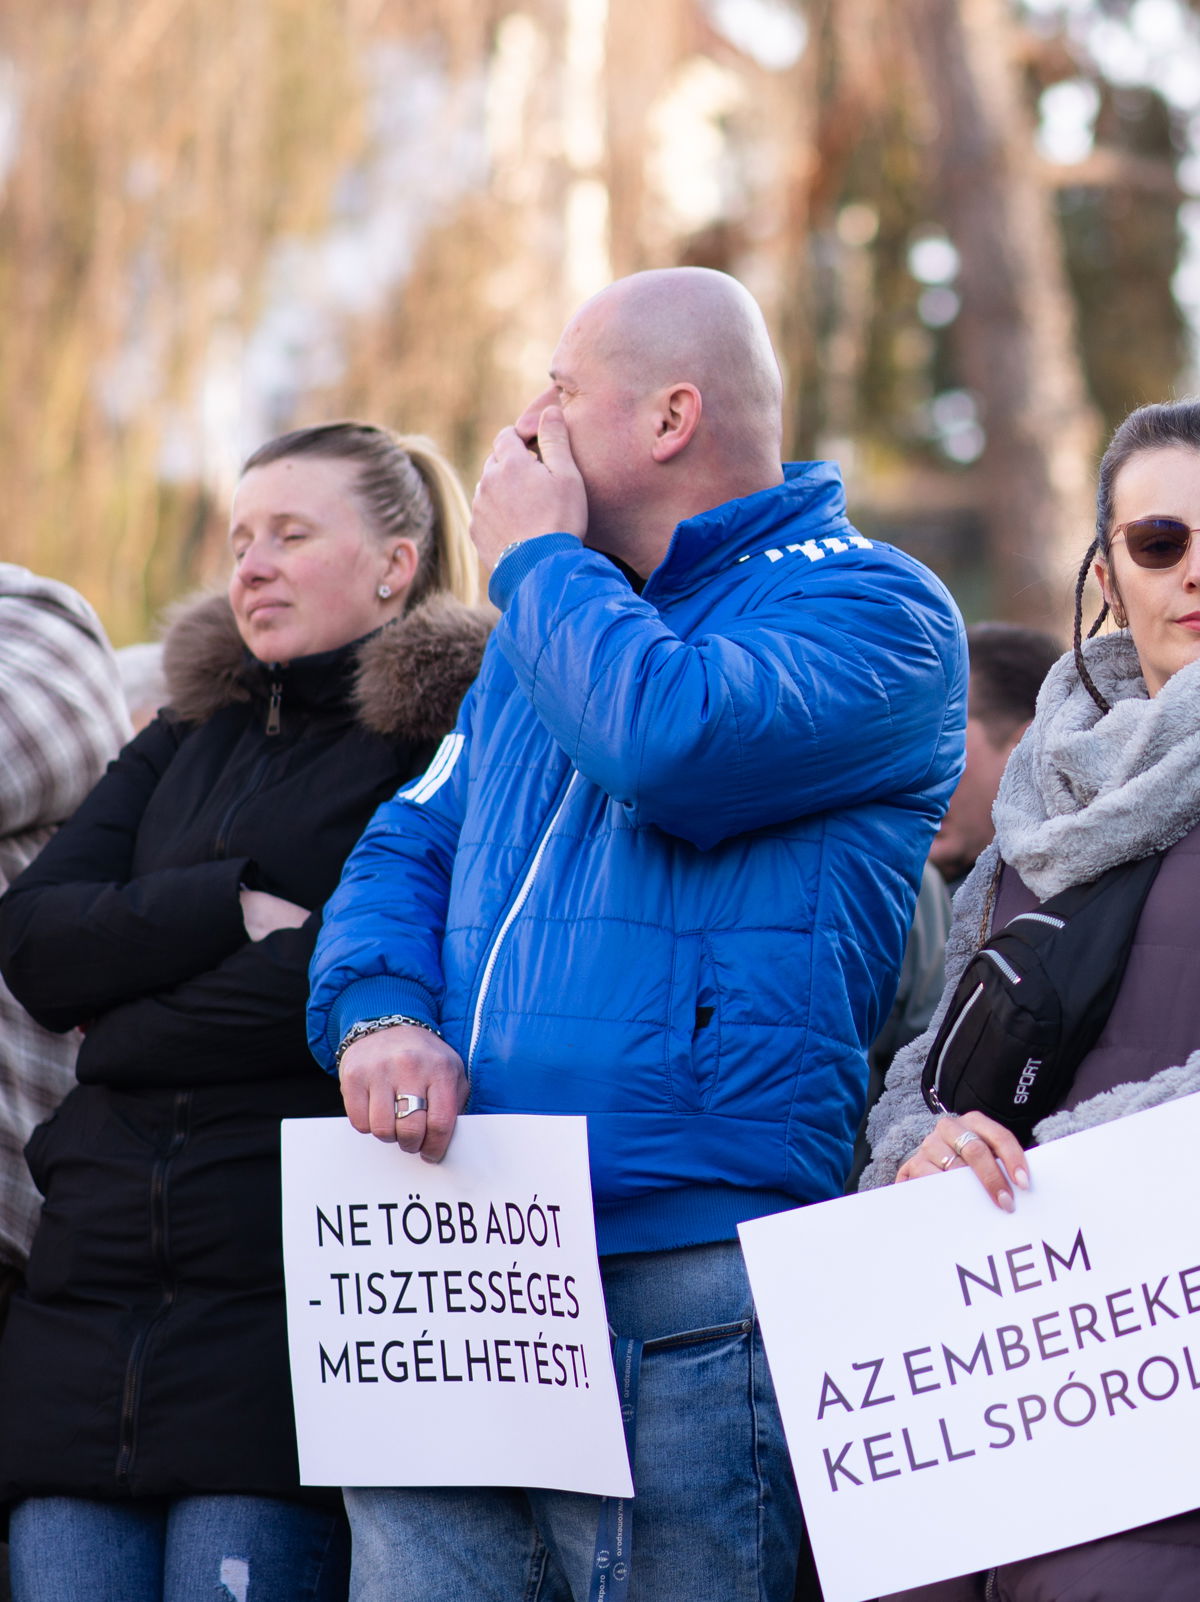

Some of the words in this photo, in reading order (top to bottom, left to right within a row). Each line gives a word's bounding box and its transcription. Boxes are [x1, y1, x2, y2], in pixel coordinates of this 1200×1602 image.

[1013, 1057, 1042, 1104] SPORT
[316, 1203, 371, 1247] NE
[377, 1193, 478, 1246] TÖBB
[485, 1193, 561, 1248] ADÓT
[955, 1227, 1092, 1307] NEM
[318, 1329, 590, 1389] MEGÉLHETÉST!
[816, 1357, 896, 1421] AZ
[822, 1417, 977, 1493] KELL
